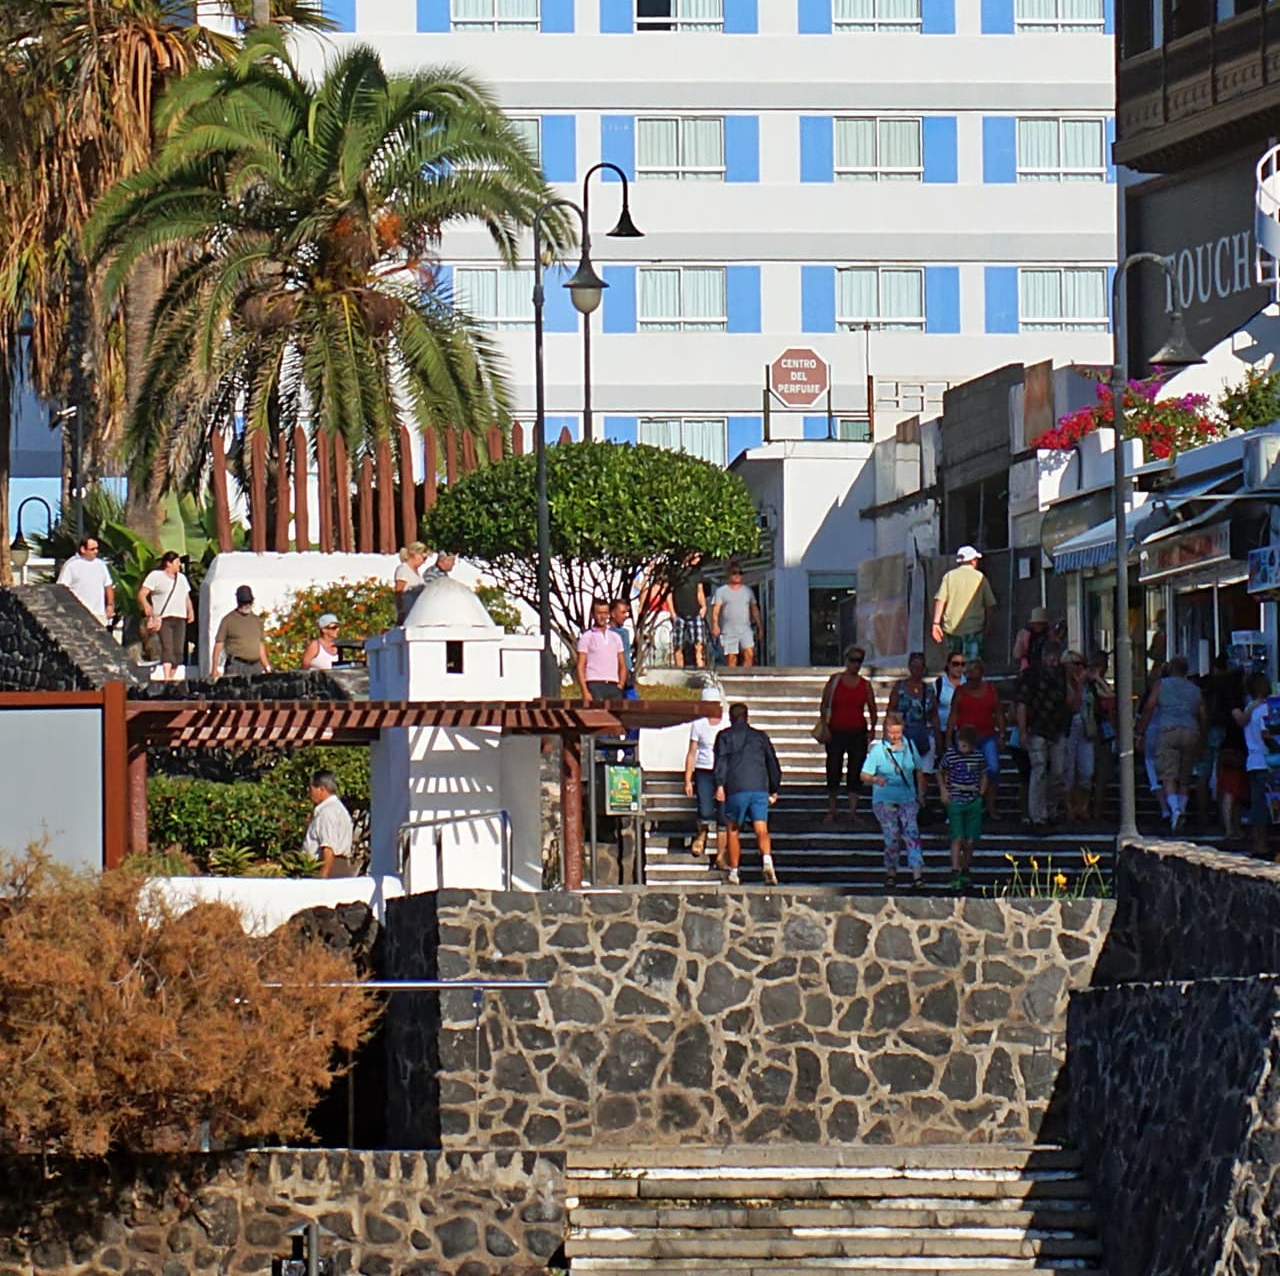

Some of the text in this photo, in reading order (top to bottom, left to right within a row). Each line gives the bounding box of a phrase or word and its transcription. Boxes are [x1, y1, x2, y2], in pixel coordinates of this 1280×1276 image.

[1164, 230, 1252, 314] TOUCH
[781, 358, 817, 369] CENTRO
[790, 371, 808, 381] DEL
[777, 384, 821, 394] PERFUME
